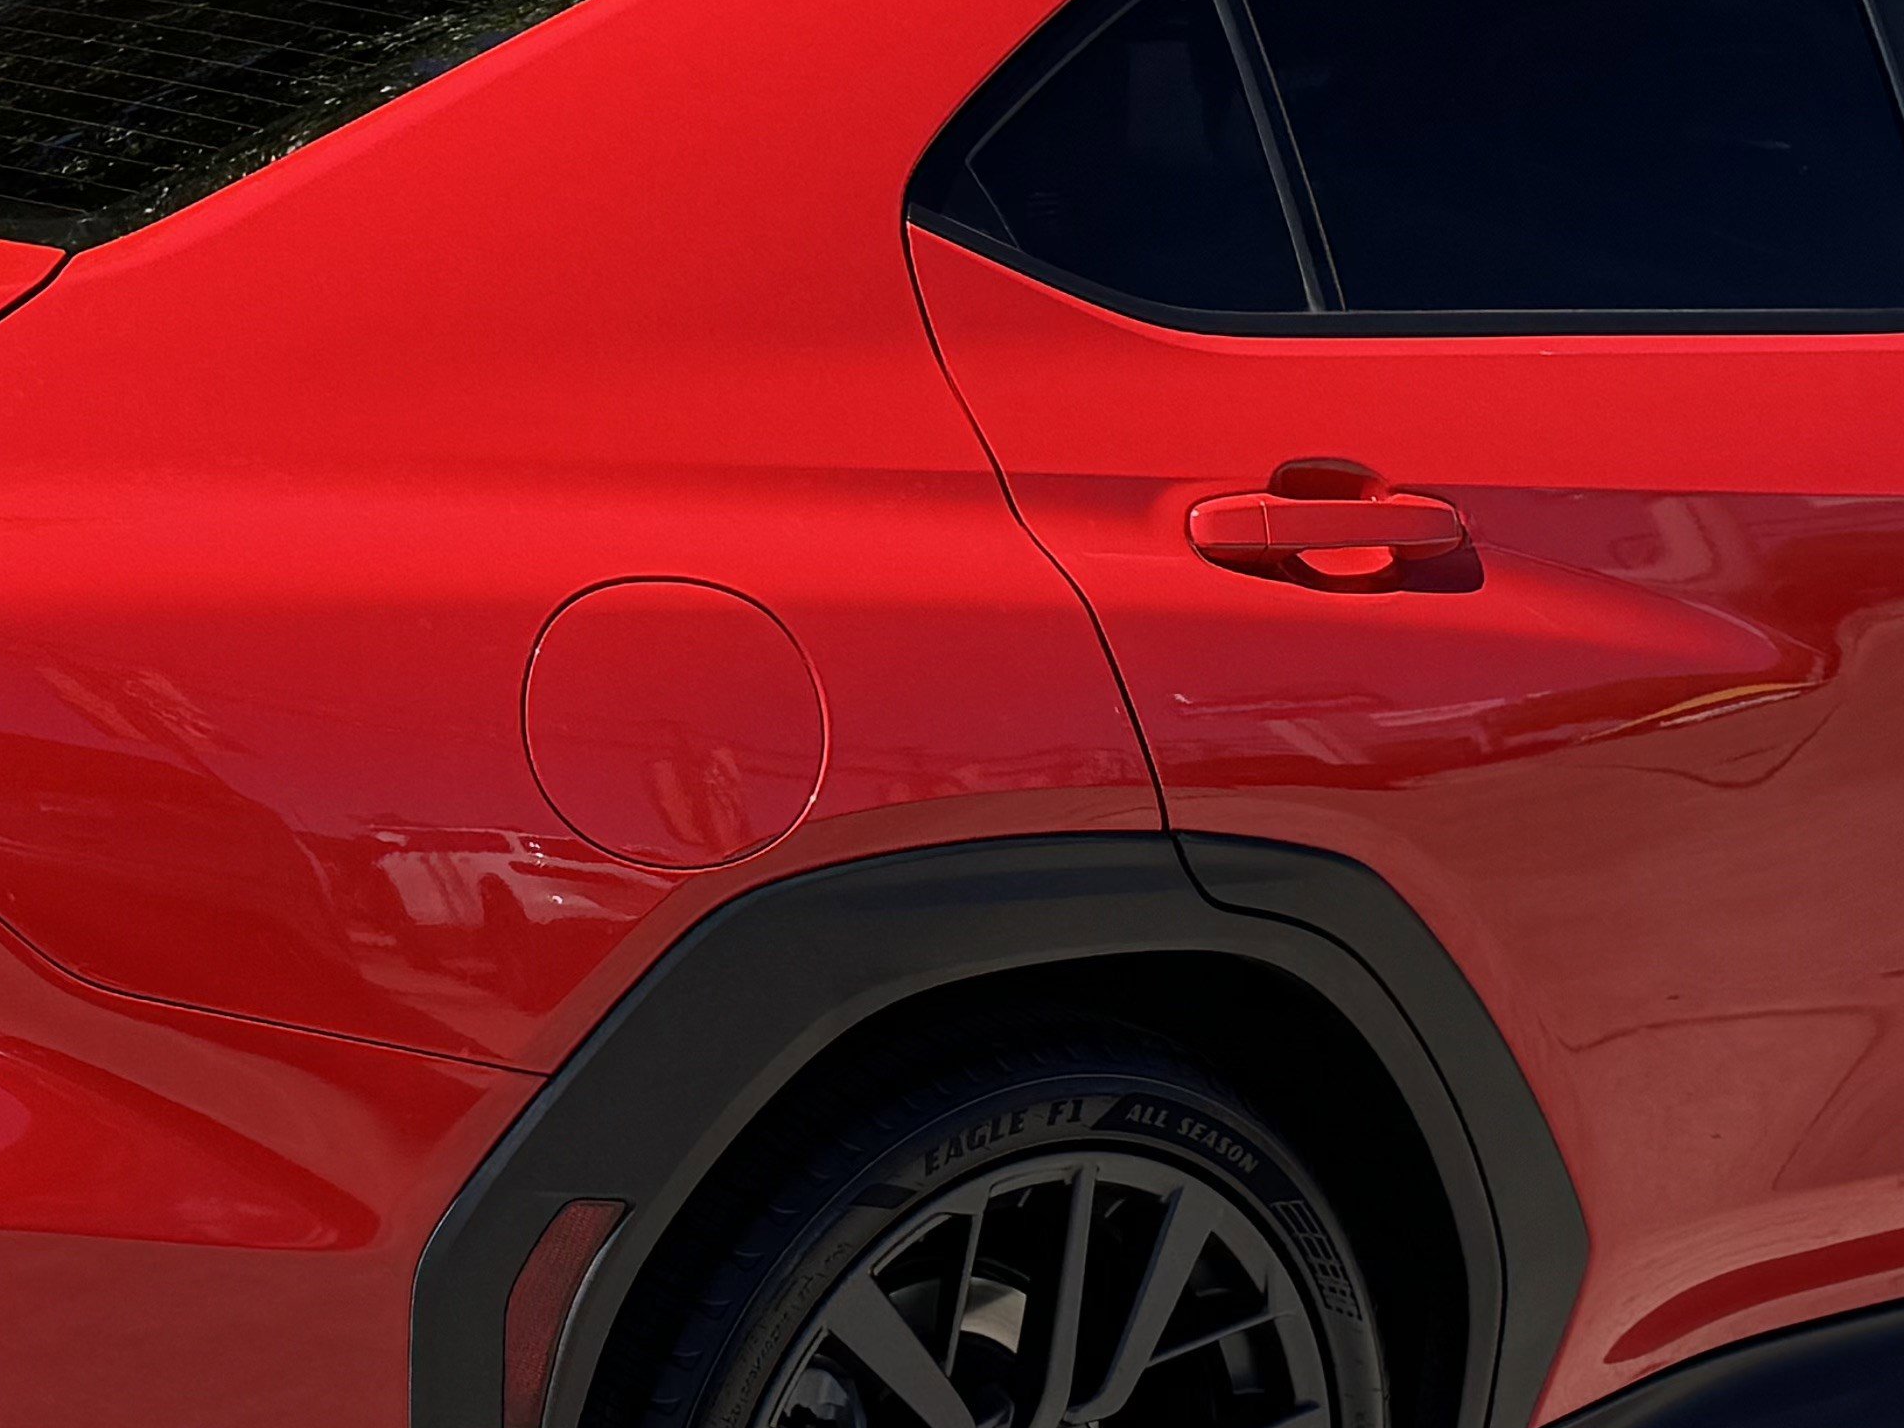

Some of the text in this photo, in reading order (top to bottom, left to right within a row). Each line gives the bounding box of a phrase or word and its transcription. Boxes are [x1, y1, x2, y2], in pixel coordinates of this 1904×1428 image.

[924, 1098, 1261, 1175] EAGLE F1 ALL SEASON
